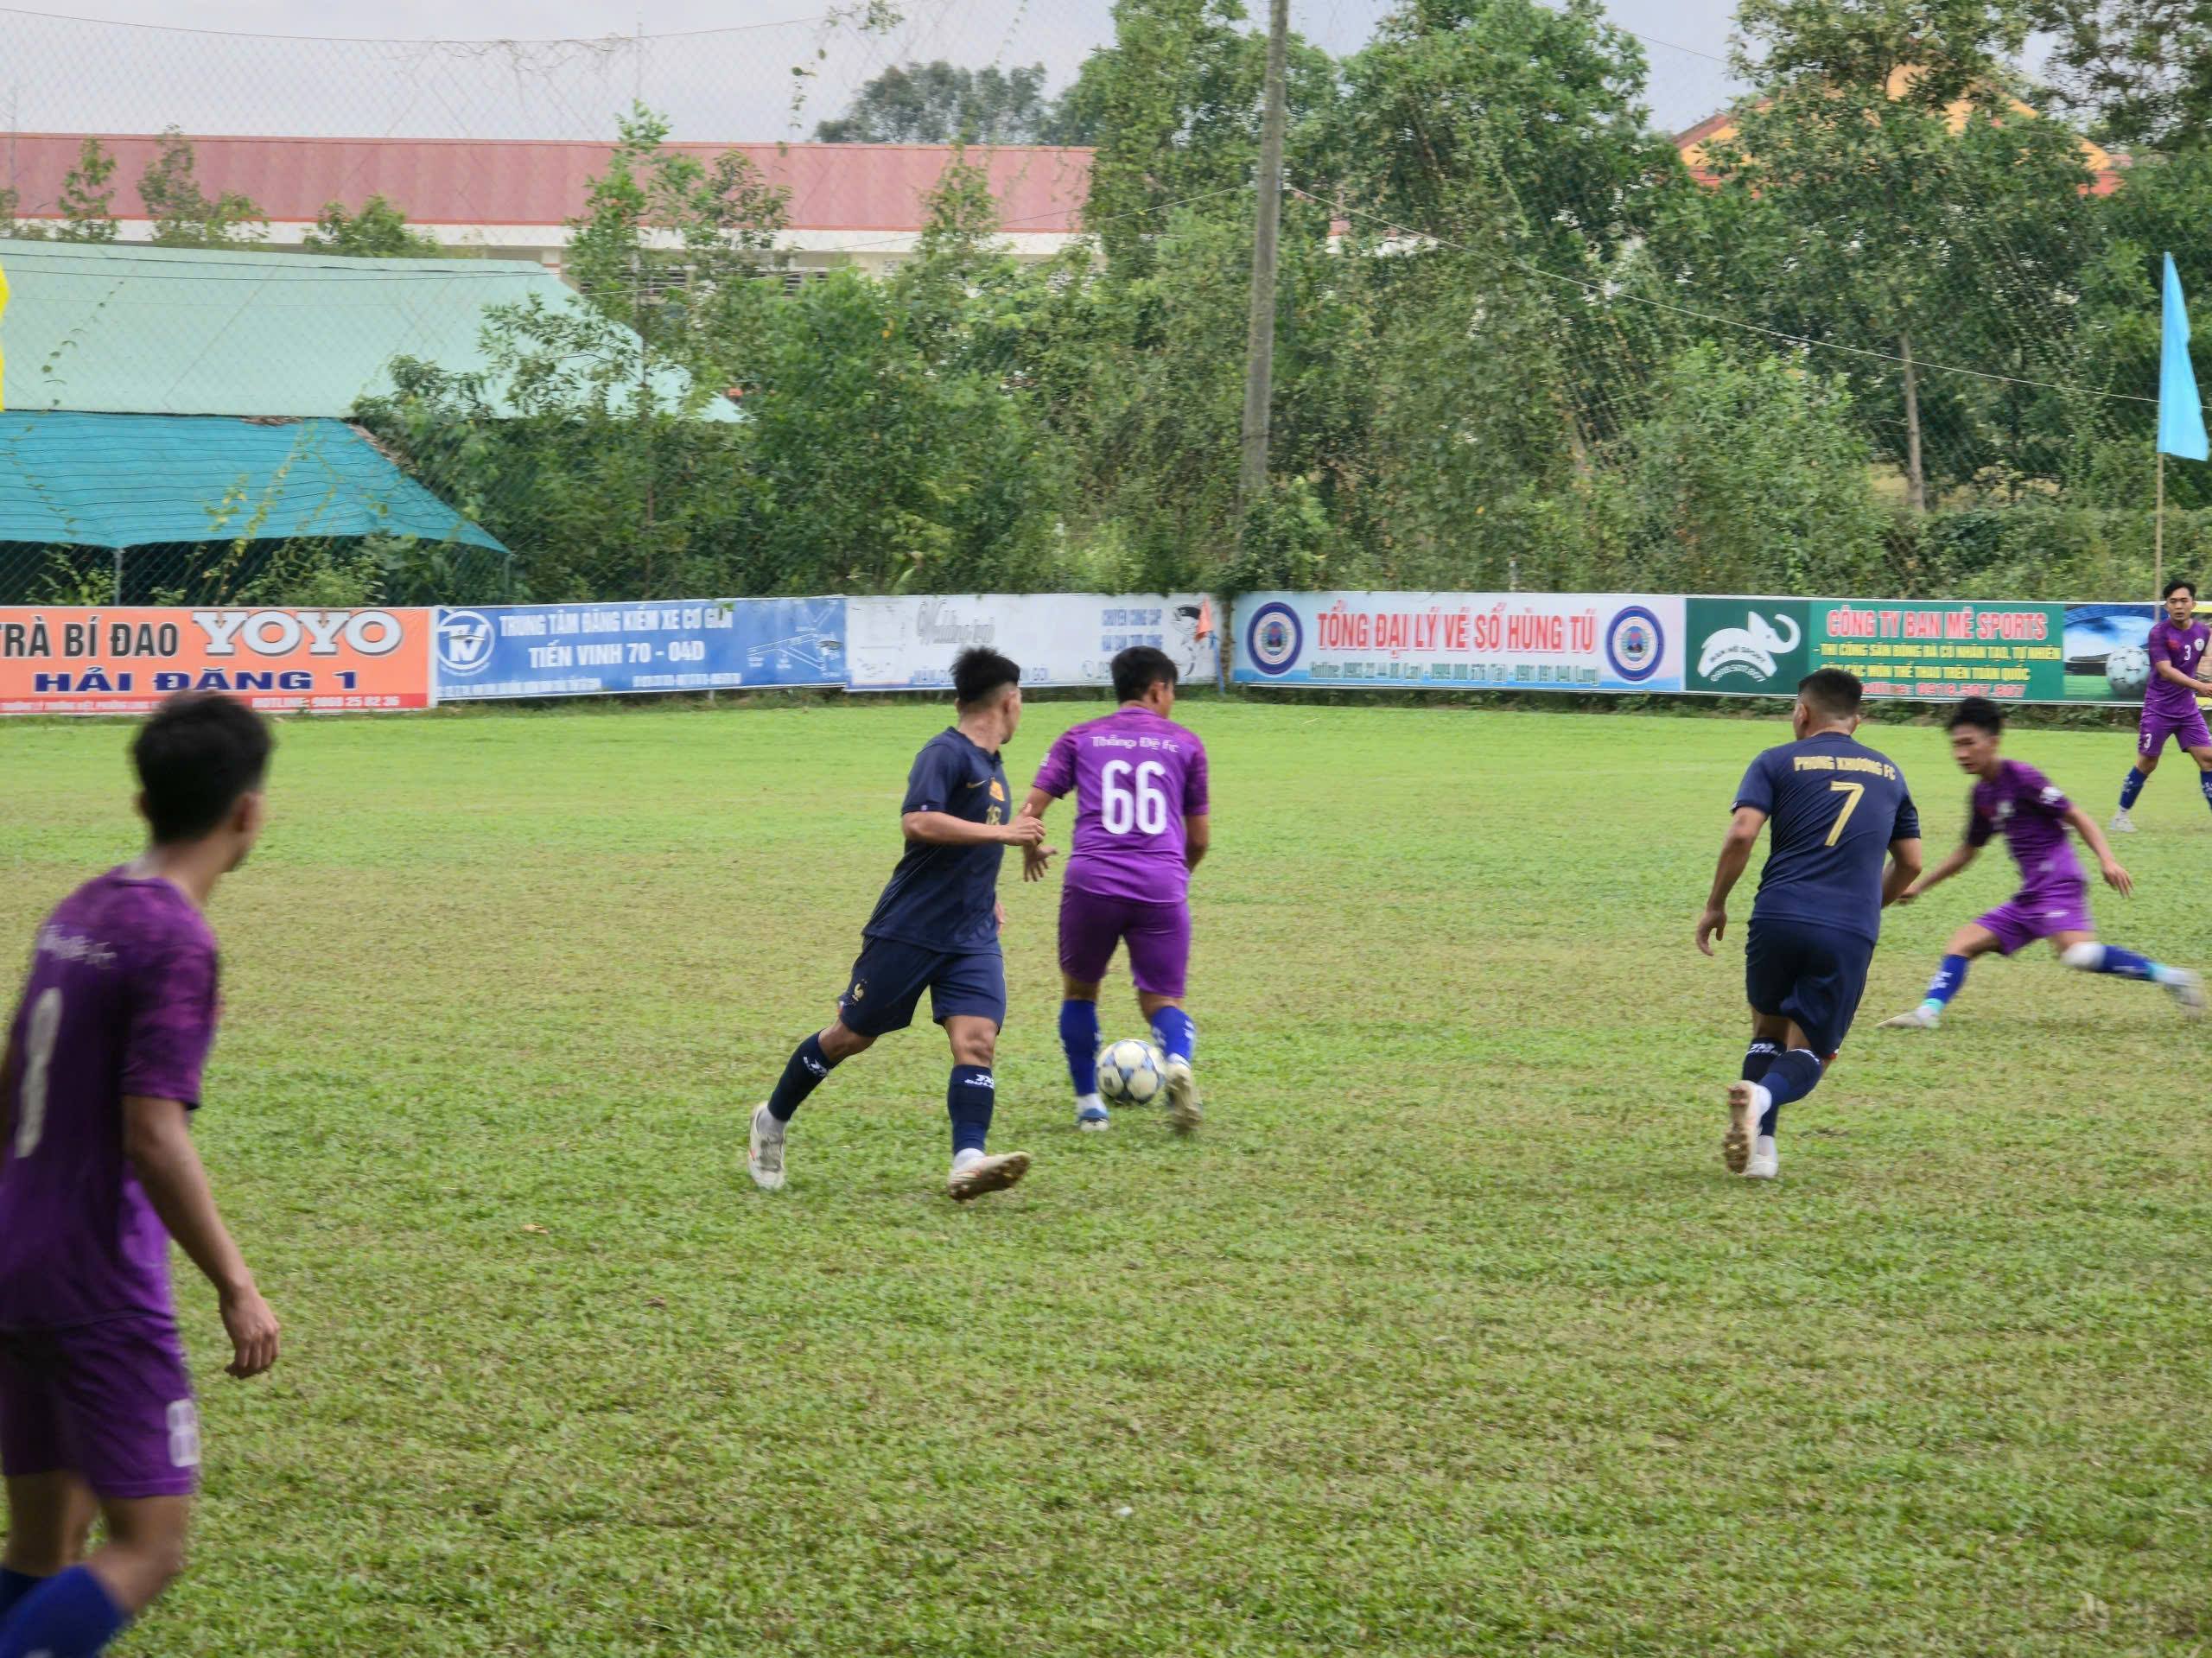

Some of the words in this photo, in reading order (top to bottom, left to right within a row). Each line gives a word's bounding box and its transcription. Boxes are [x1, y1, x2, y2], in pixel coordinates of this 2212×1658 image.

[64, 614, 97, 657] BÍ
[111, 622, 178, 657] ĐAO
[193, 610, 404, 657] YOYO
[548, 609, 579, 634] TÂM
[662, 611, 679, 630] XE
[1317, 600, 1370, 651] TỔNG
[1374, 613, 1410, 658] ĐẠI
[1414, 607, 1440, 651] LÝ
[1443, 607, 1470, 652] VÉ
[1473, 602, 1506, 652] SỐ
[1507, 607, 1565, 653] HÙNG
[1827, 604, 1876, 638] CÔNG
[1878, 610, 1903, 638] TY
[1904, 611, 1942, 639] BAN
[1944, 606, 1974, 639] MÊ
[1976, 612, 2048, 640] SPORTS
[529, 640, 572, 669] TIẾN
[576, 644, 622, 666] VINH
[626, 642, 651, 664] 70
[668, 641, 705, 662] 04D
[2184, 644, 2192, 661] 3
[34, 665, 133, 693] HẢI
[154, 667, 313, 692] ĐĂNG
[334, 670, 358, 689] 1
[2143, 734, 2152, 749] 3
[1100, 759, 1167, 835] 66
[1824, 780, 1866, 848] 7
